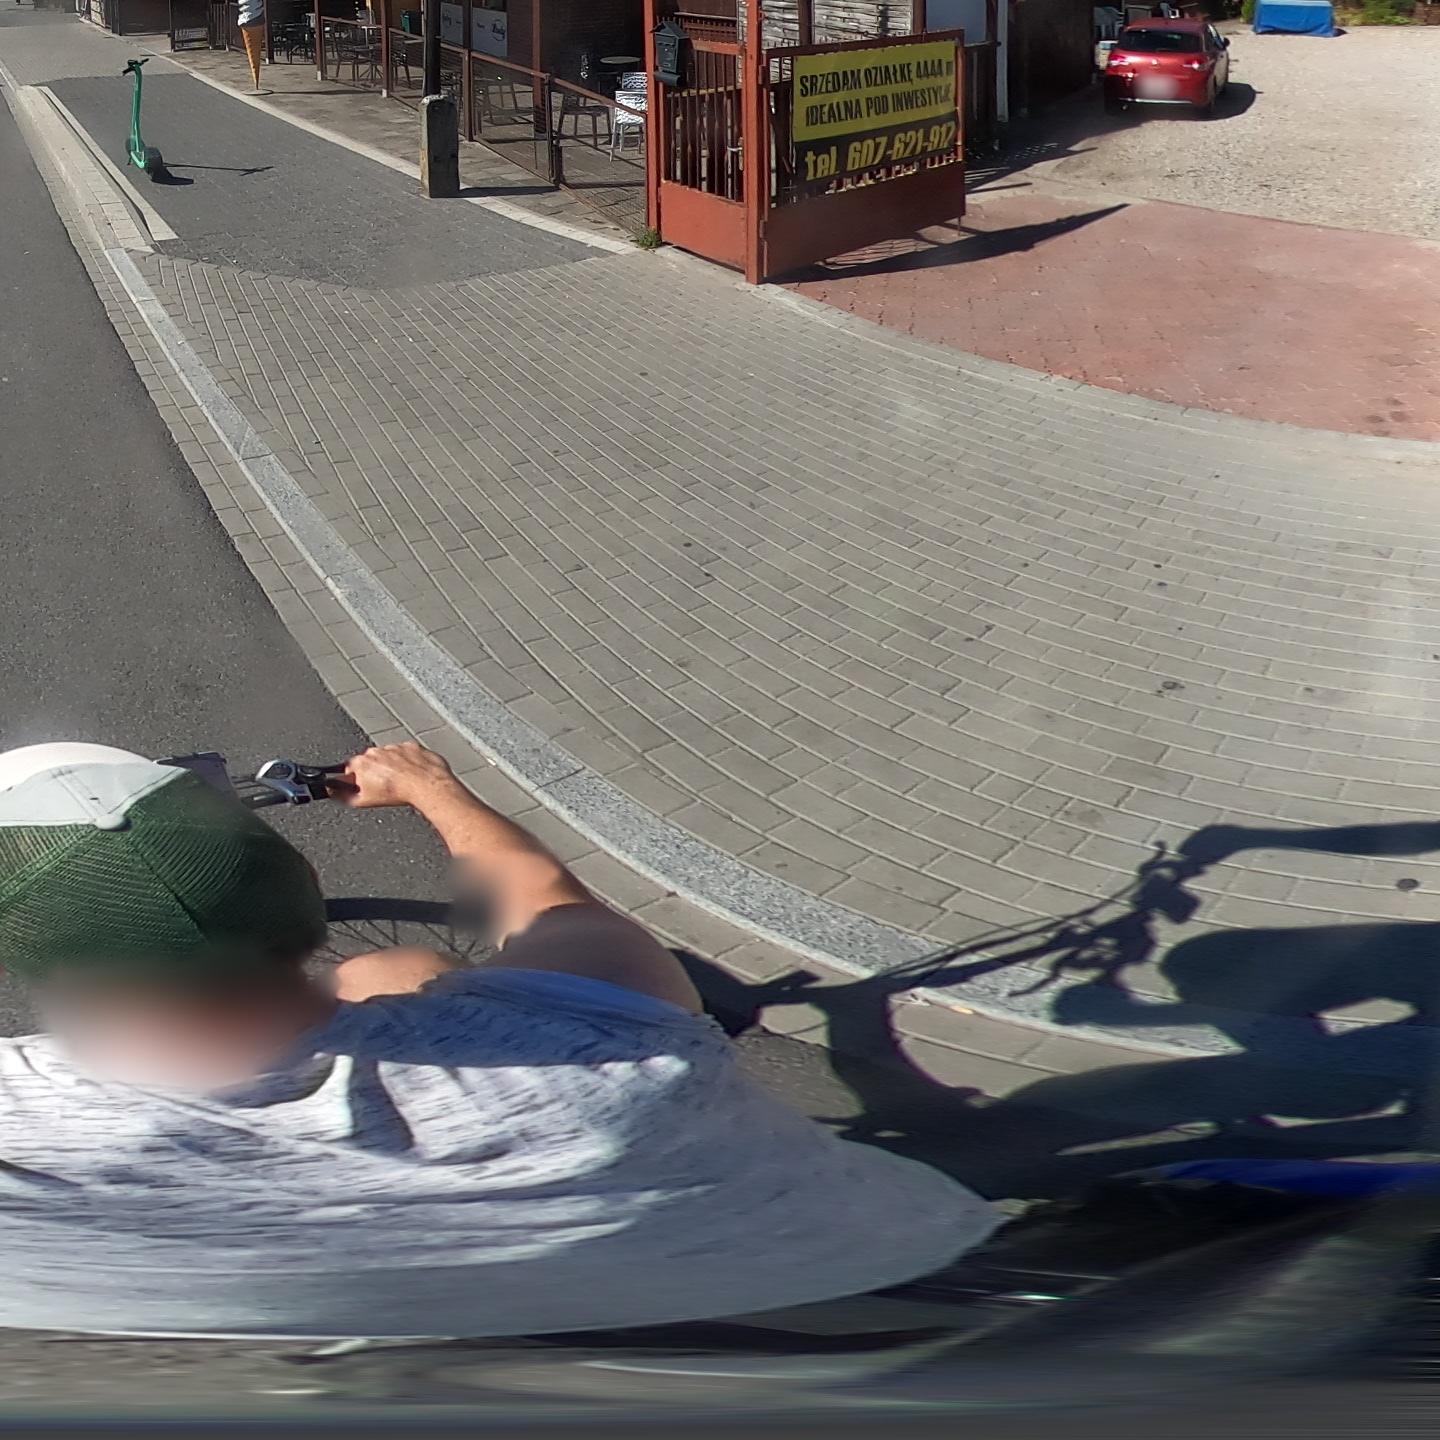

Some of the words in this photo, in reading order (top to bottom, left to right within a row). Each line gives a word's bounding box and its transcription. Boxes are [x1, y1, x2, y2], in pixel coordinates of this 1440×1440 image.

[864, 63, 913, 88] DZIAŁKĘ
[916, 59, 943, 78] 4444
[806, 98, 862, 127] IDEALNA
[866, 94, 889, 118] POD
